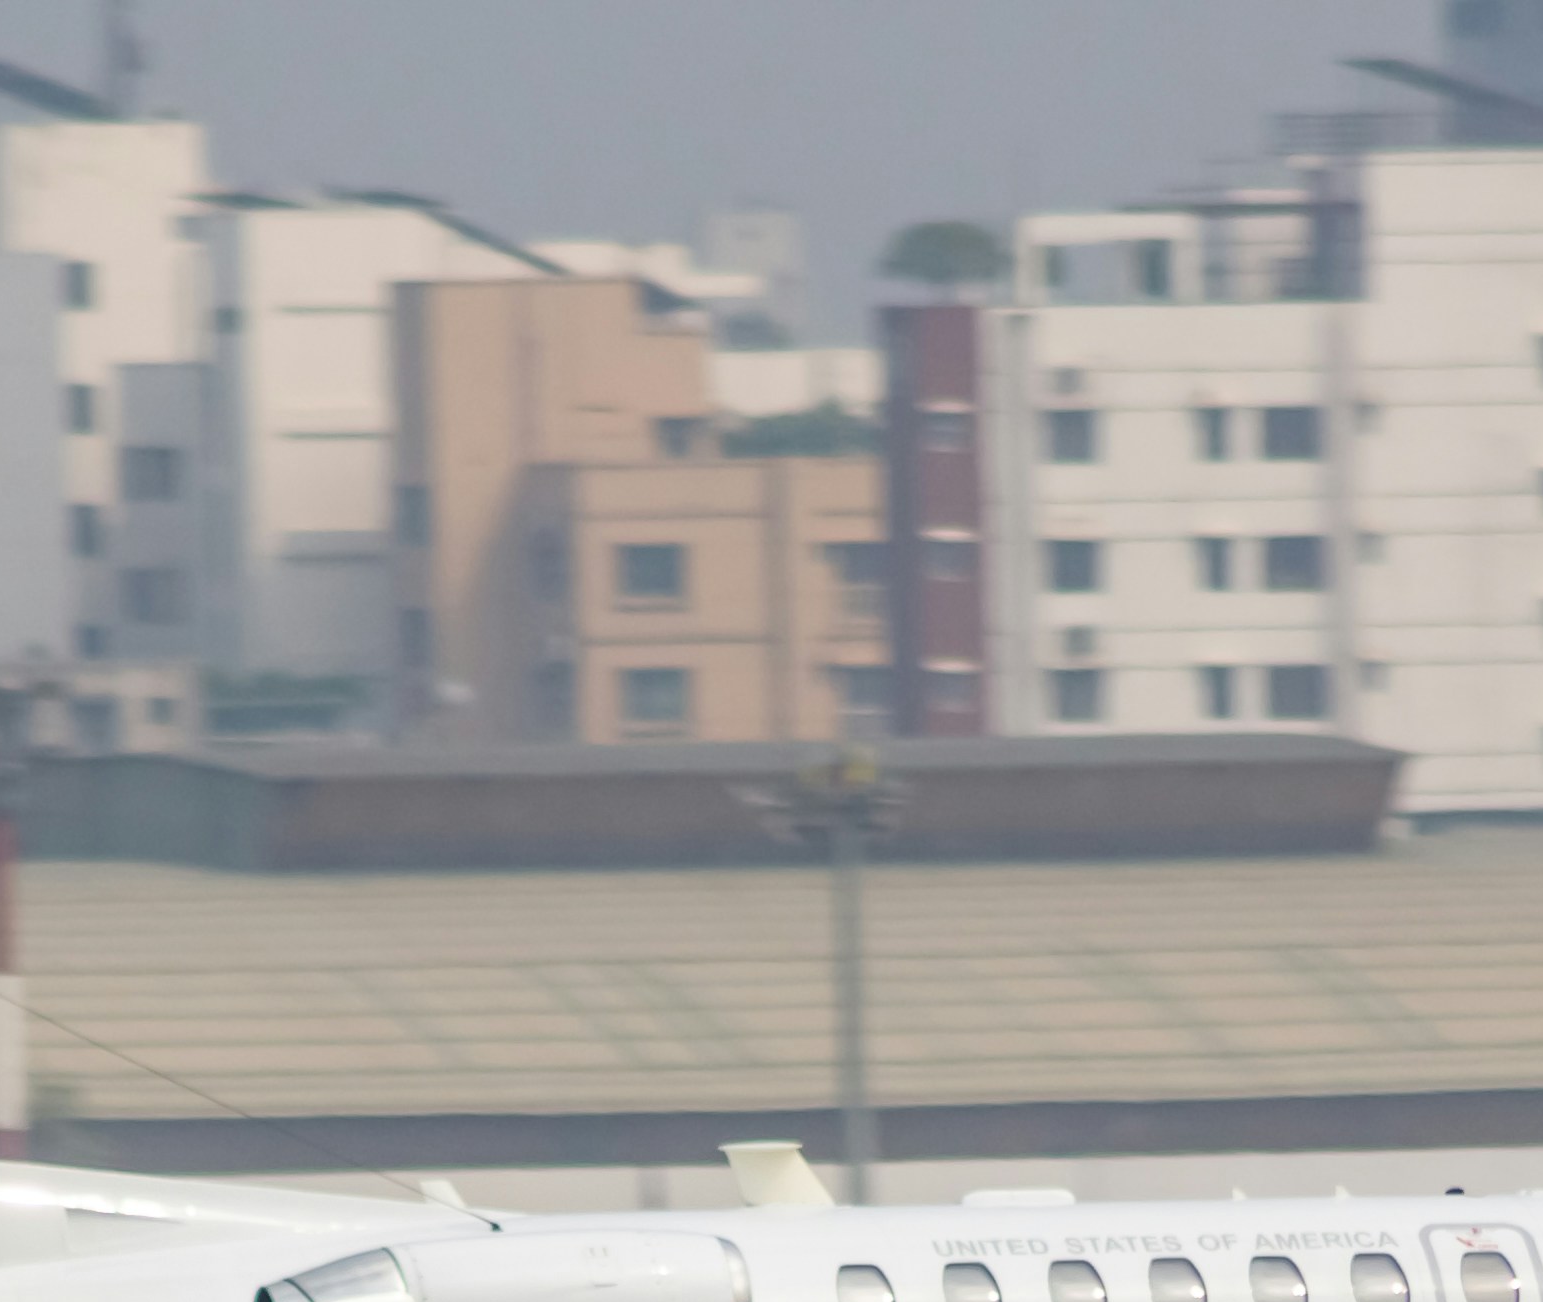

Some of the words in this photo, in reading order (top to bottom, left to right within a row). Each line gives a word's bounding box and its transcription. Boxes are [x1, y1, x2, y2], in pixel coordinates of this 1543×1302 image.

[932, 1239, 1049, 1257] UNITED
[1065, 1235, 1183, 1255] STATES
[1197, 1233, 1239, 1253] OF
[1255, 1231, 1400, 1251] AMERICA
